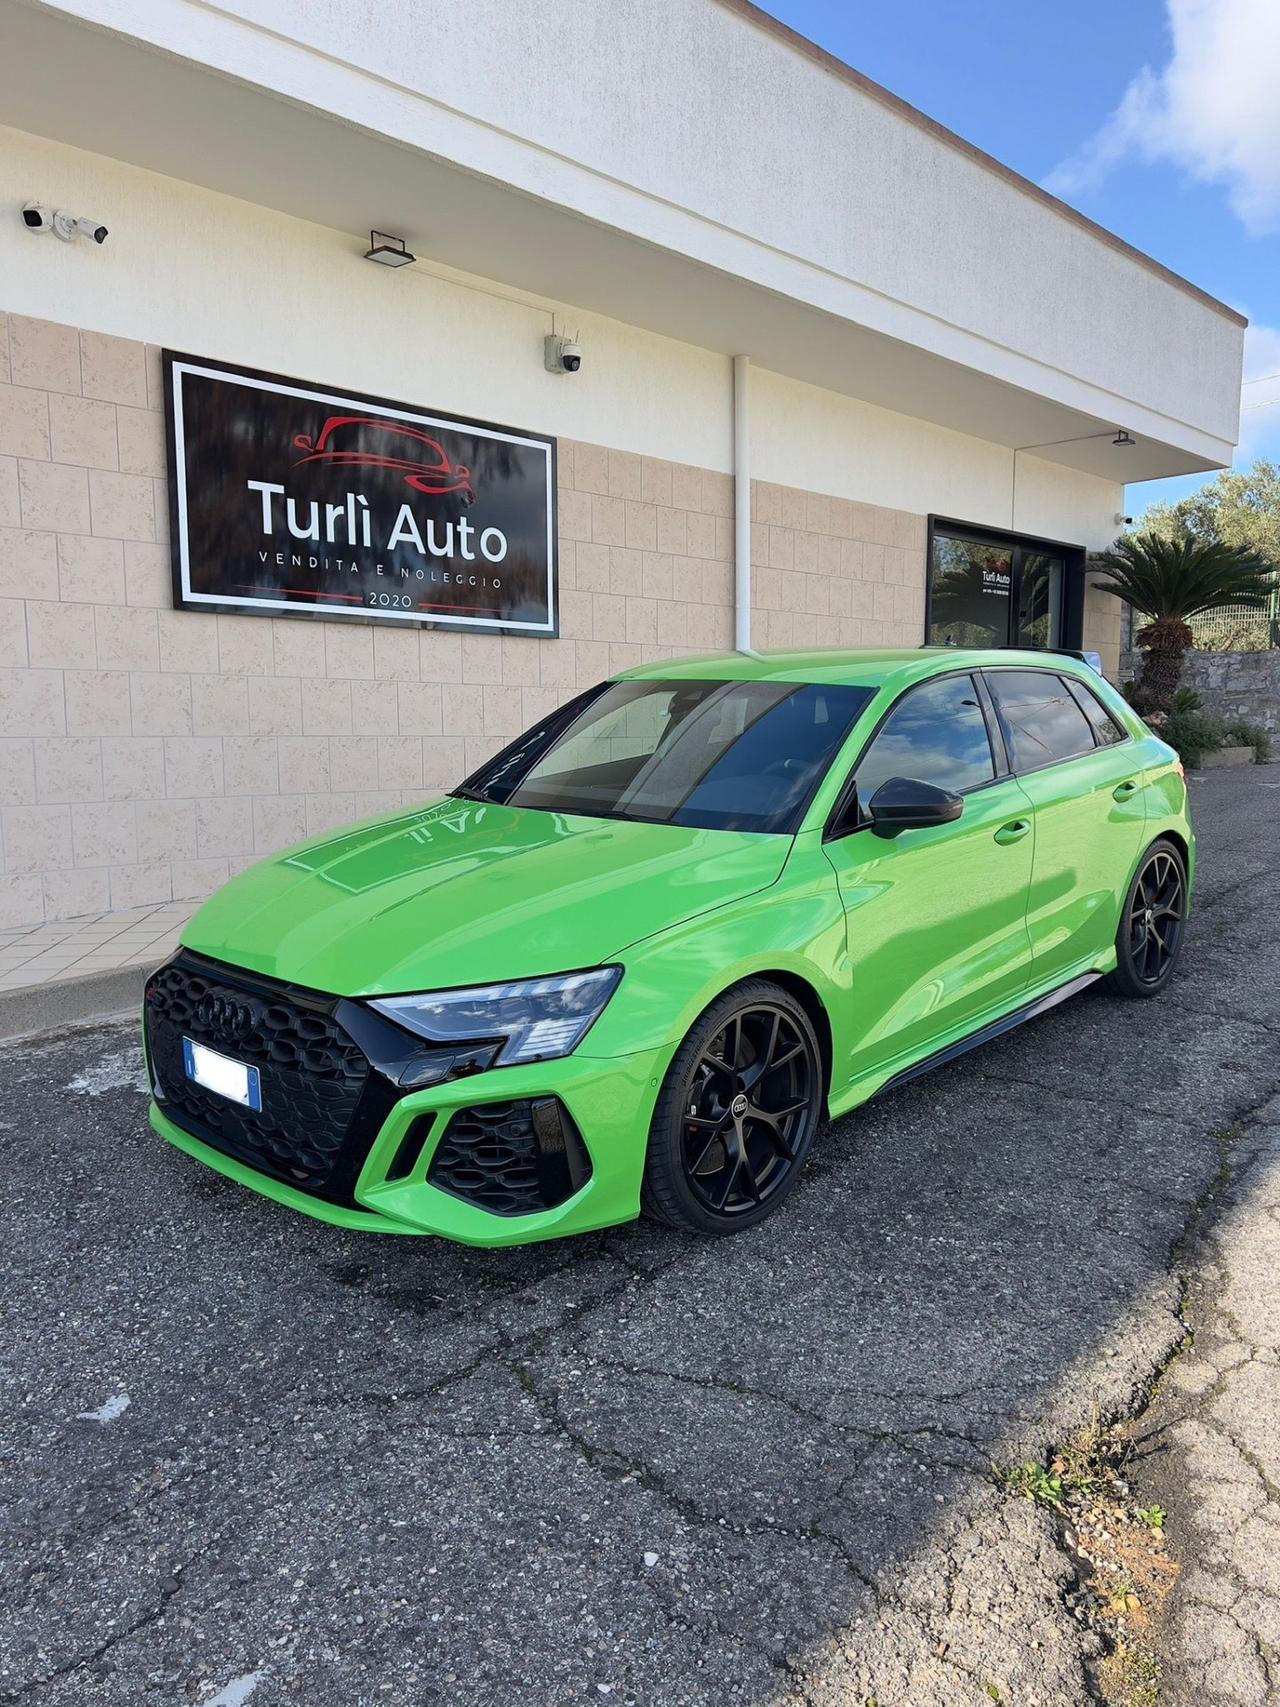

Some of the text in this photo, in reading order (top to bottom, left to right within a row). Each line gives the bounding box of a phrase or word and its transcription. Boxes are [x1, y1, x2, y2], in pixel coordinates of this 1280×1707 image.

[248, 480, 507, 563] Turlì Auto
[258, 551, 501, 589] VENDITA E NOLEGGIO
[369, 592, 412, 608] 2020
